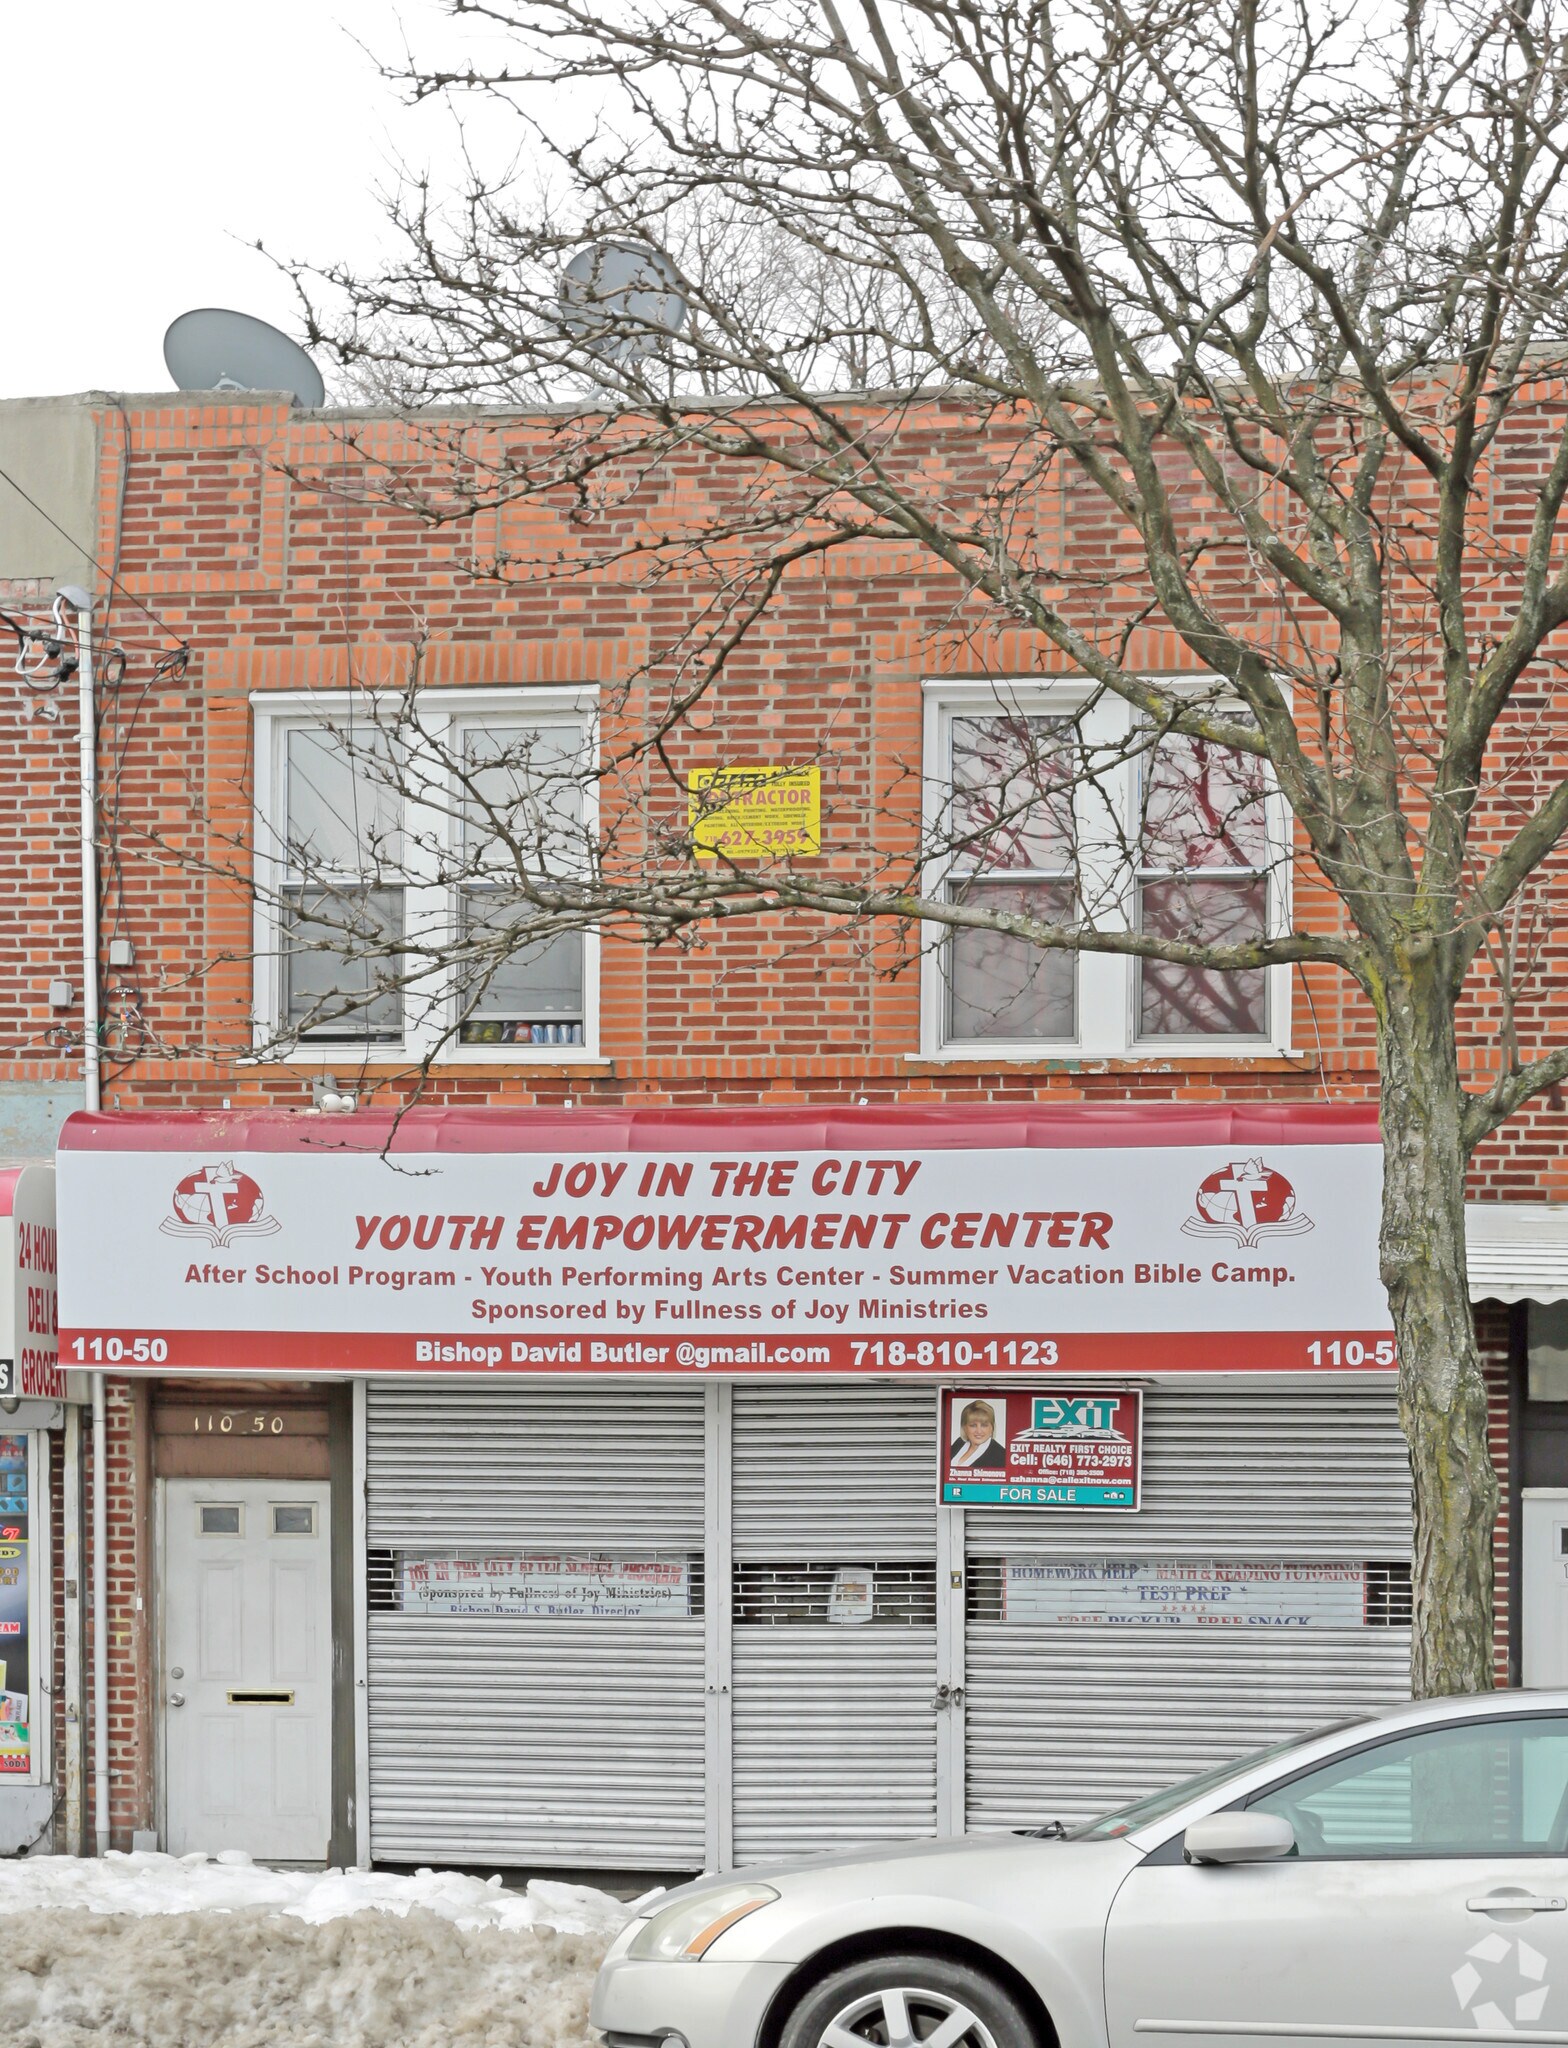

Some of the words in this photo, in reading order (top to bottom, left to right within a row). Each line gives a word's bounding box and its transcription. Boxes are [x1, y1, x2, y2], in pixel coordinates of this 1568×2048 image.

[721, 829, 807, 846] 627-3959
[533, 1161, 628, 1198] JOY
[638, 1161, 693, 1197] IN
[709, 1160, 798, 1196] THE
[812, 1160, 921, 1196] CITY
[355, 1215, 505, 1250] YOUTH
[517, 1213, 910, 1251] EMPOWERMENT
[921, 1211, 1114, 1249] CENTER
[19, 1221, 31, 1269] 24
[185, 1264, 247, 1284] After
[255, 1264, 338, 1284] School
[348, 1265, 456, 1291] Program
[480, 1266, 553, 1286] Youth
[562, 1266, 703, 1291] Performing
[712, 1266, 768, 1286] Arts
[776, 1266, 864, 1286] Center
[889, 1266, 1000, 1286] Summer
[1008, 1265, 1124, 1285] Vacation
[1134, 1264, 1201, 1284] Bible
[1211, 1262, 1296, 1288] Camp.
[28, 1286, 49, 1334] DELI
[472, 1299, 607, 1323] Sponsored
[616, 1299, 645, 1324] by
[655, 1299, 762, 1319] Fullness
[771, 1299, 795, 1319] of
[805, 1300, 849, 1324] Joy
[859, 1298, 988, 1318] Ministries
[72, 1337, 168, 1363] 110-50
[416, 1341, 503, 1368] Bishop
[511, 1341, 582, 1363] David
[590, 1341, 670, 1363] Butler
[675, 1341, 830, 1369] @gmail.com
[850, 1340, 1059, 1366] 718-810-1123
[1307, 1340, 1399, 1366] 110-5
[194, 1415, 233, 1433] 110
[1010, 1443, 1030, 1453] EXIT
[1033, 1443, 1066, 1454] REALTY
[1069, 1444, 1095, 1454] FIRST
[1098, 1444, 1132, 1455] CHOICE
[1010, 1454, 1038, 1466] Cell:
[1042, 1454, 1072, 1468] (646)
[1076, 1455, 1132, 1467] 773-2973
[1000, 1488, 1031, 1501] FOR
[1037, 1489, 1077, 1502] SALE
[1011, 1562, 1097, 1580] HOMEWORK
[1102, 1562, 1139, 1580] HELP
[1156, 1563, 1197, 1580] MATH
[1284, 1563, 1361, 1581] TUTORING
[582, 1587, 600, 1602] Joy
[1137, 1585, 1182, 1601] TEST
[1186, 1585, 1232, 1601] PREP
